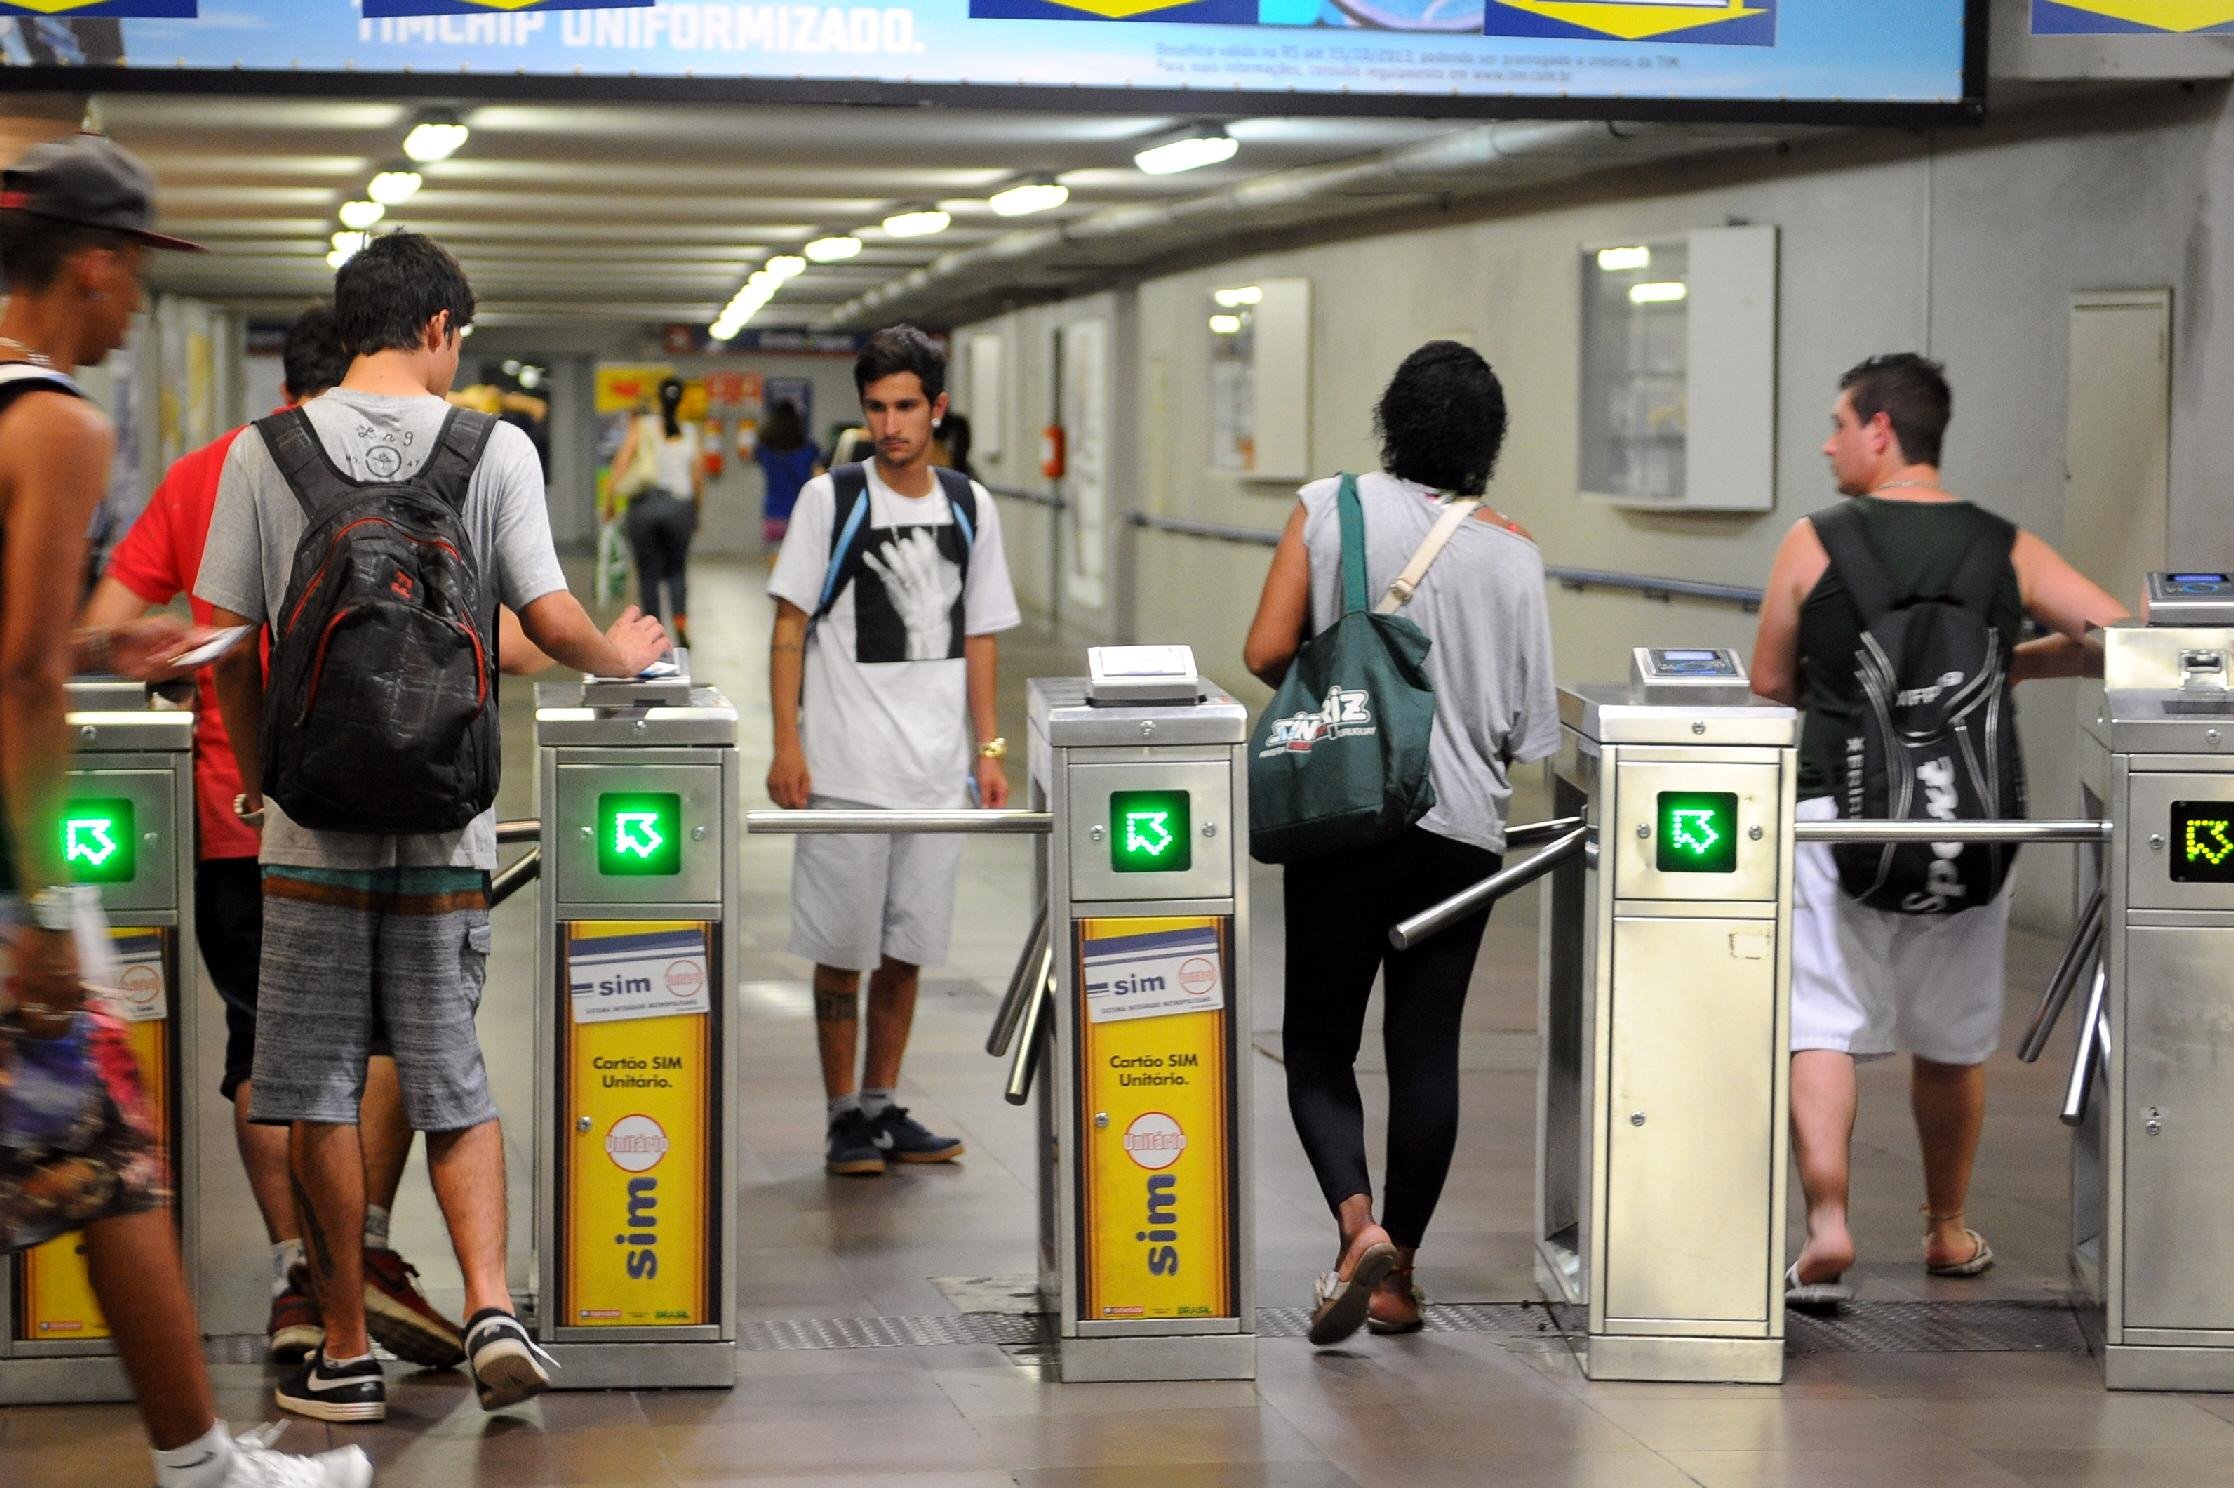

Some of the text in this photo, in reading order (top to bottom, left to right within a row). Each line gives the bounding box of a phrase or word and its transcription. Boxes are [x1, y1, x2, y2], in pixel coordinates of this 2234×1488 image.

[561, 5, 926, 53] UNIFORMIZADO.
[599, 974, 651, 996] sim
[1114, 973, 1165, 995] sim
[593, 1056, 682, 1070] Cartão SIM
[1110, 1053, 1198, 1068] Cartão SIM
[602, 1074, 673, 1088] Unitário.
[1119, 1072, 1189, 1087] Unitário.
[616, 1177, 658, 1280] sim
[1136, 1174, 1178, 1276] sim
